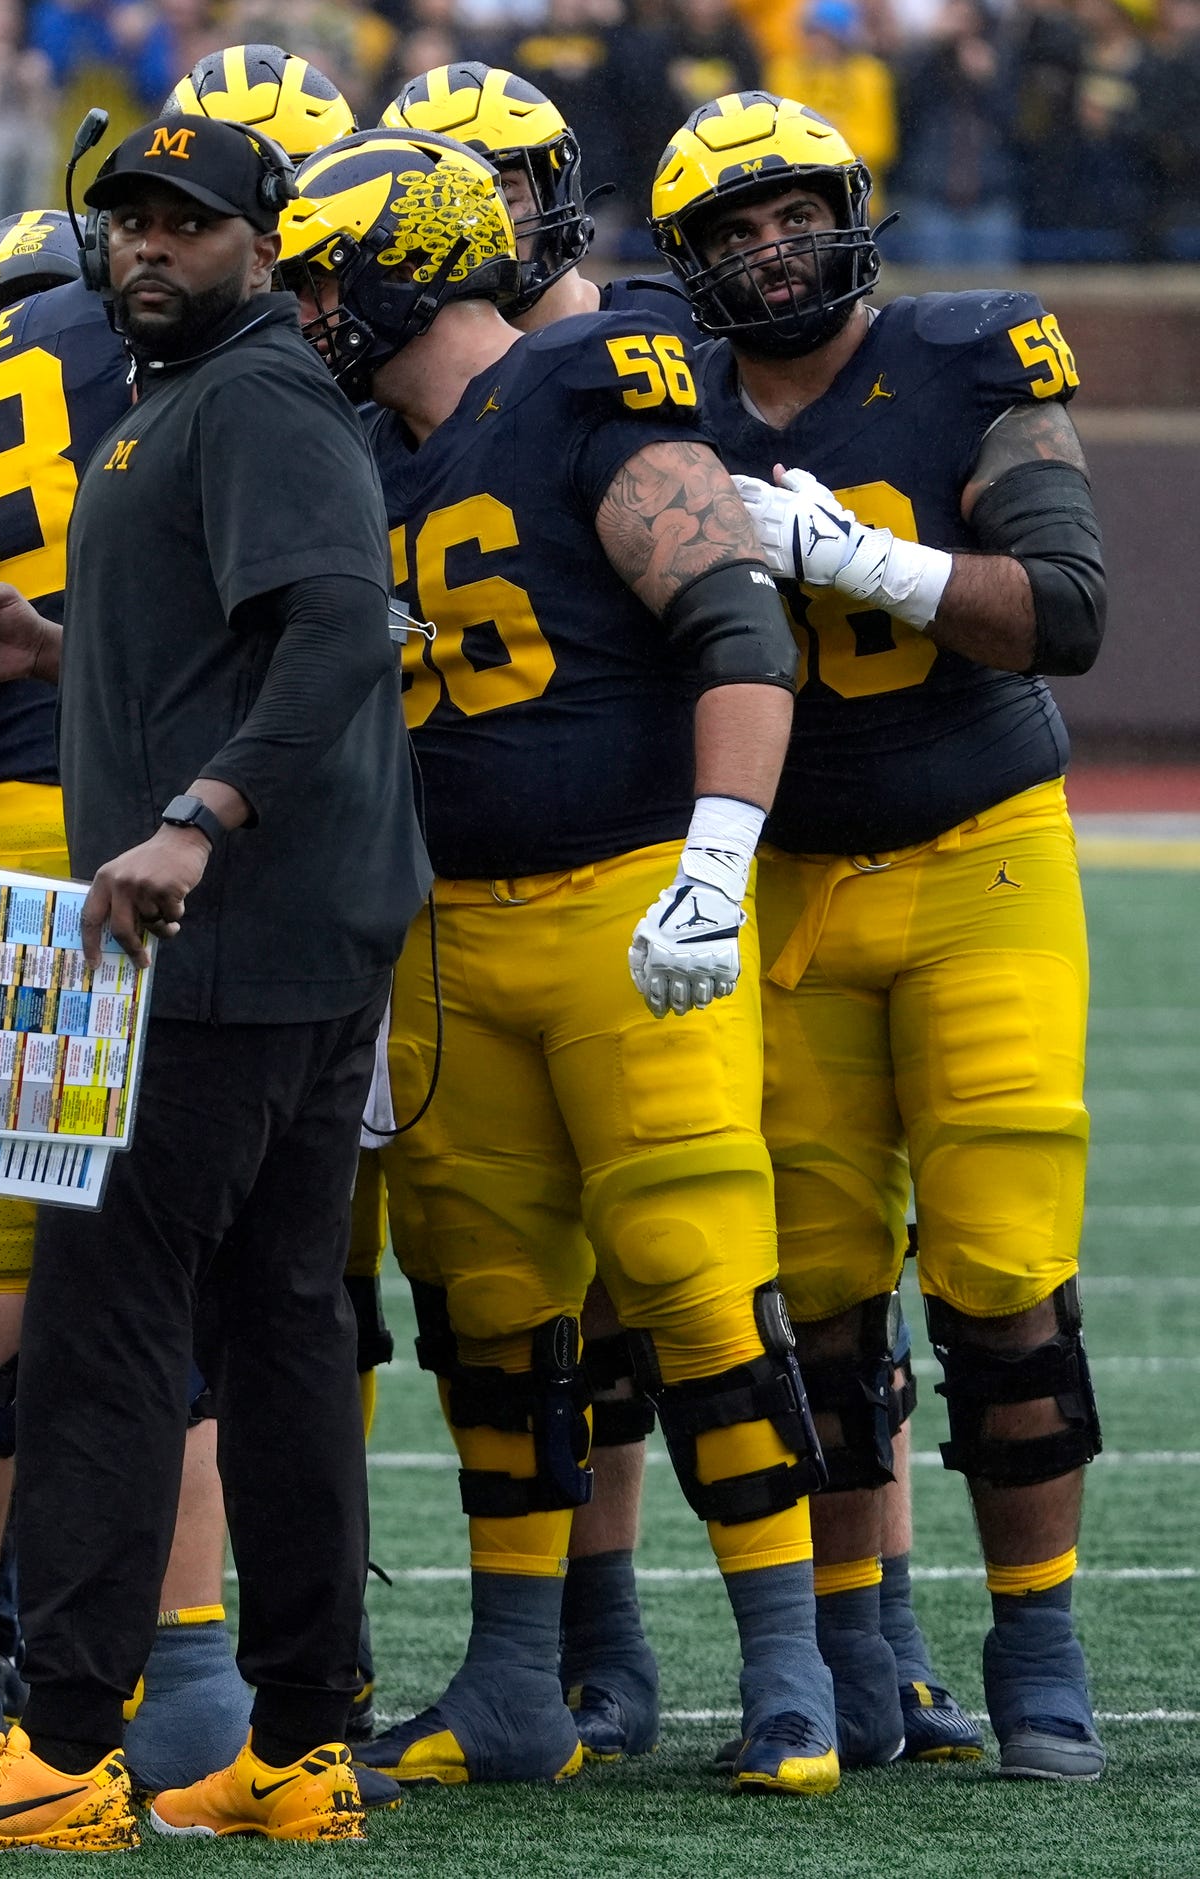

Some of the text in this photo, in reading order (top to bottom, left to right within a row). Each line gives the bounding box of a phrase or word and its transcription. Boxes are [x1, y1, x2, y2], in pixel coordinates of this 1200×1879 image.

[144, 127, 196, 160] M
[451, 269, 464, 277] ED
[606, 334, 698, 411] 56
[1008, 313, 1081, 399] 58
[103, 438, 139, 470] M
